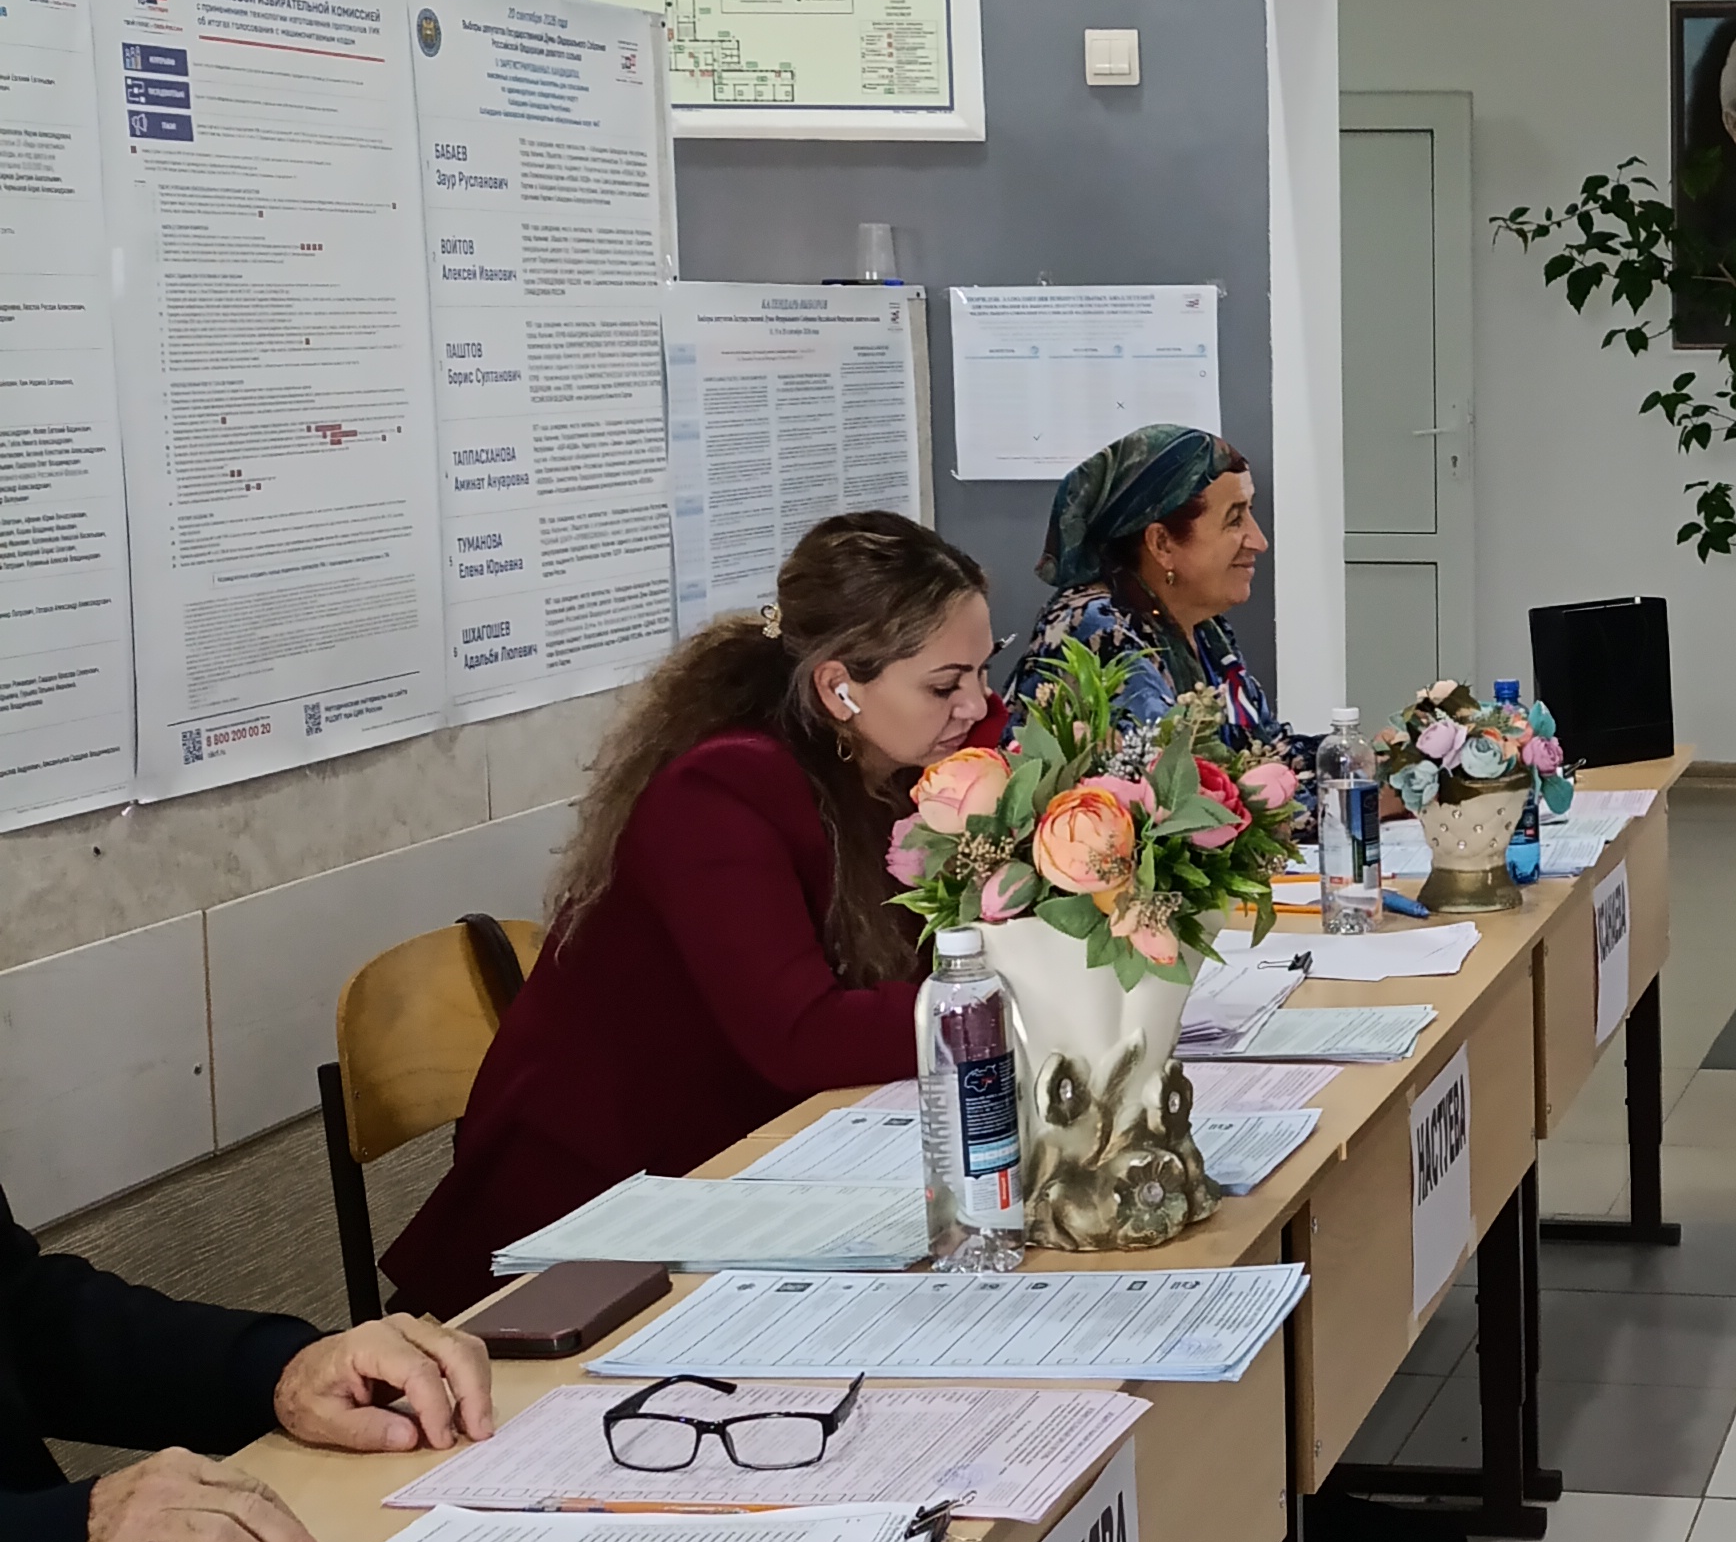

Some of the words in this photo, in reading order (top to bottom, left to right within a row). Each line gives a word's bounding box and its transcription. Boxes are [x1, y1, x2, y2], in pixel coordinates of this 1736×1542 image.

[331, 3, 381, 23] КОМИССИЕЙ
[435, 143, 467, 162] БАБАЕВ
[436, 169, 456, 190] Заур
[458, 171, 508, 190] Русланович
[441, 235, 474, 255] ВОЙТОВ
[442, 264, 477, 281] Алексей
[479, 266, 517, 281] Иванович
[446, 342, 483, 359] ПАШТОВ
[447, 368, 473, 386] Борис
[475, 368, 522, 386] Султанович
[454, 476, 485, 491] Аминат
[487, 472, 530, 490] Ануаровна
[457, 533, 503, 554] ТУМАНОВА
[458, 561, 484, 579] Елена
[486, 557, 524, 576] Юрьевна
[462, 621, 511, 645] ШХАГОШЕВ
[463, 650, 500, 670] Адальби
[206, 735, 212, 747] 8
[213, 731, 230, 746] 800
[231, 727, 248, 742] 200
[249, 725, 260, 738] 00
[261, 722, 271, 735] 20
[1416, 1074, 1467, 1207] НАСТУЕВА
